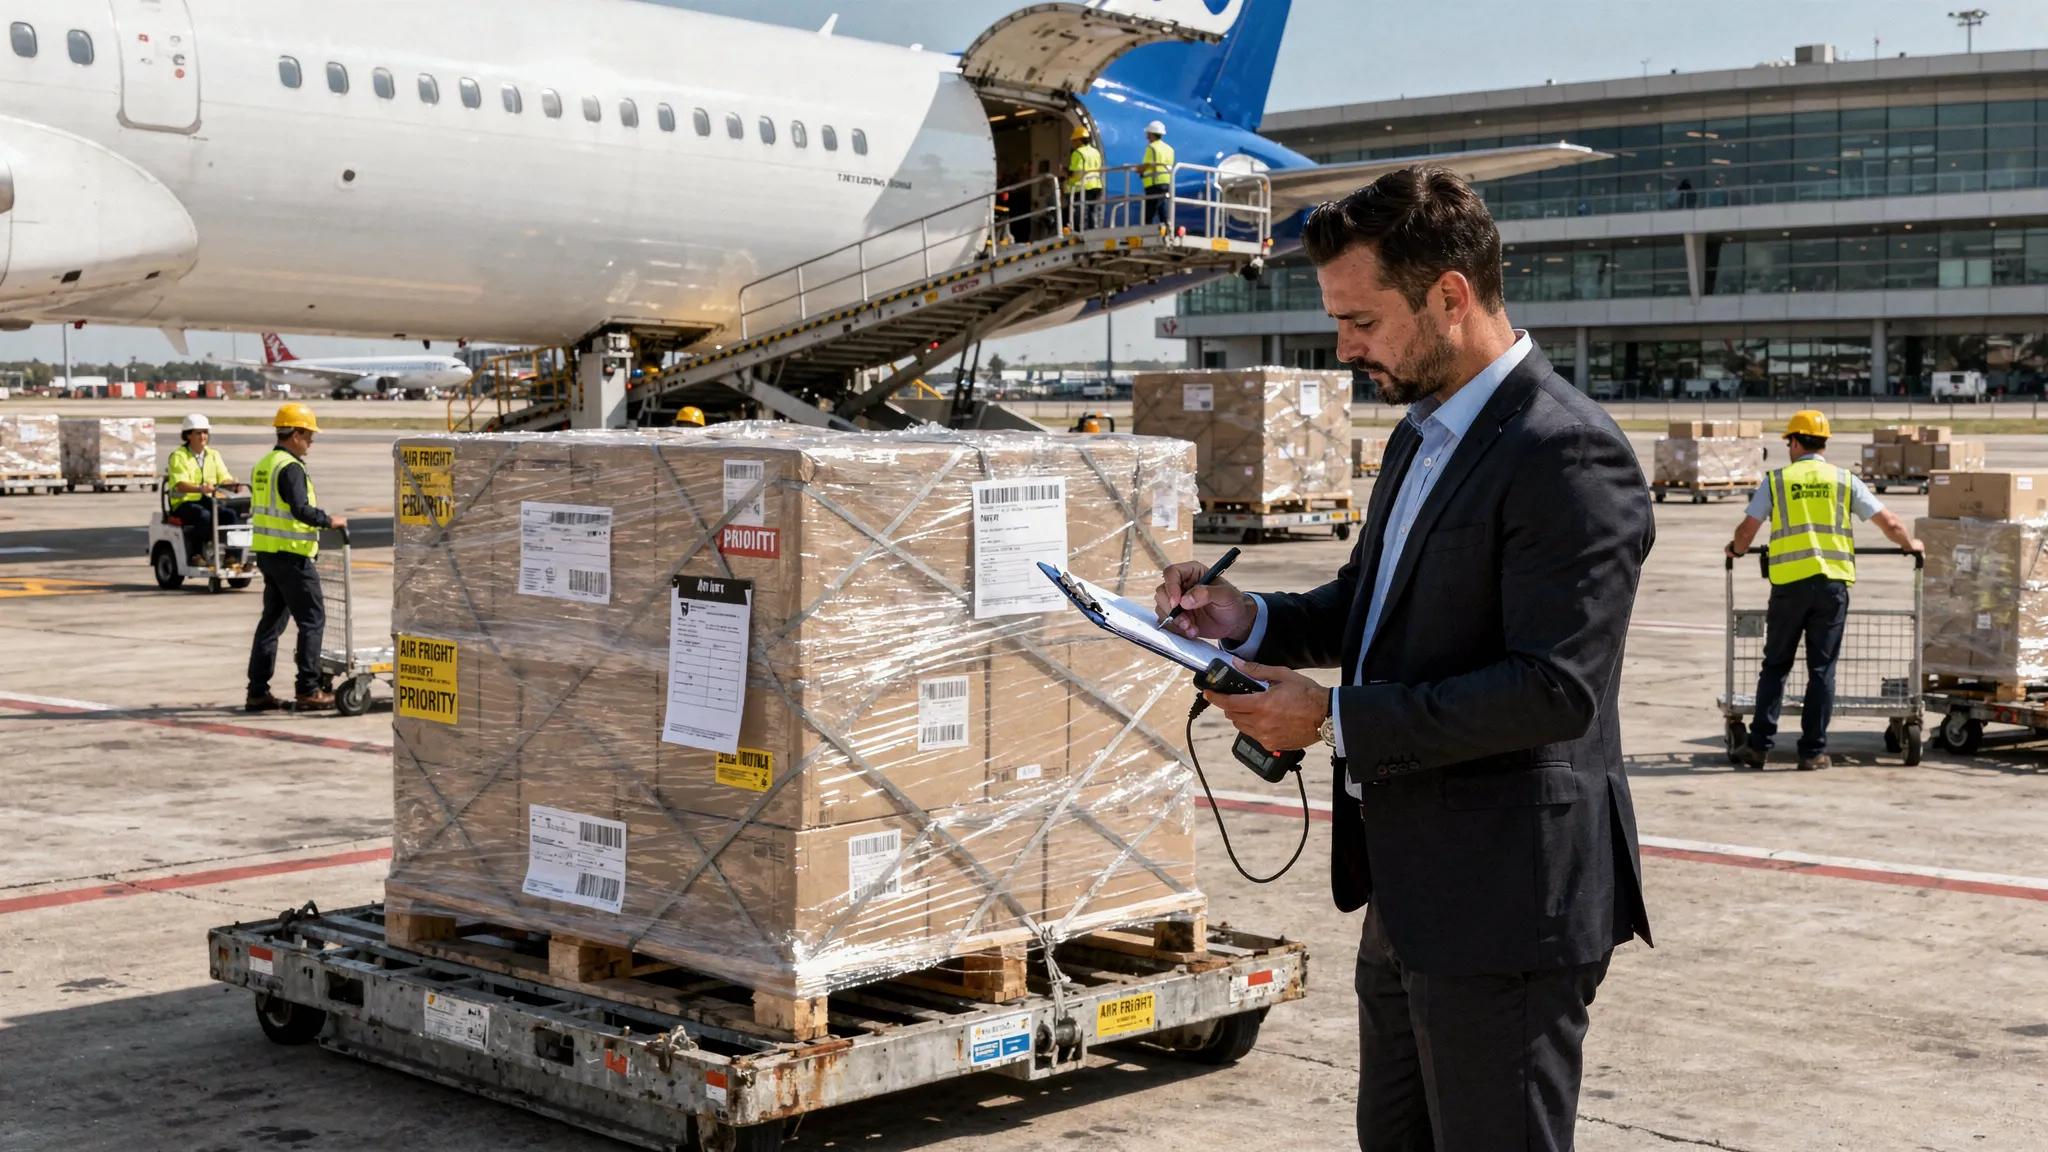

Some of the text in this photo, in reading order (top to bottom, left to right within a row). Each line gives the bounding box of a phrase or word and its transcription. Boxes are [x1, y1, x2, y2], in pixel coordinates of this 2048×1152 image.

[400, 640, 455, 664] AIR FRIGHT
[400, 686, 457, 715] PRIORITY
